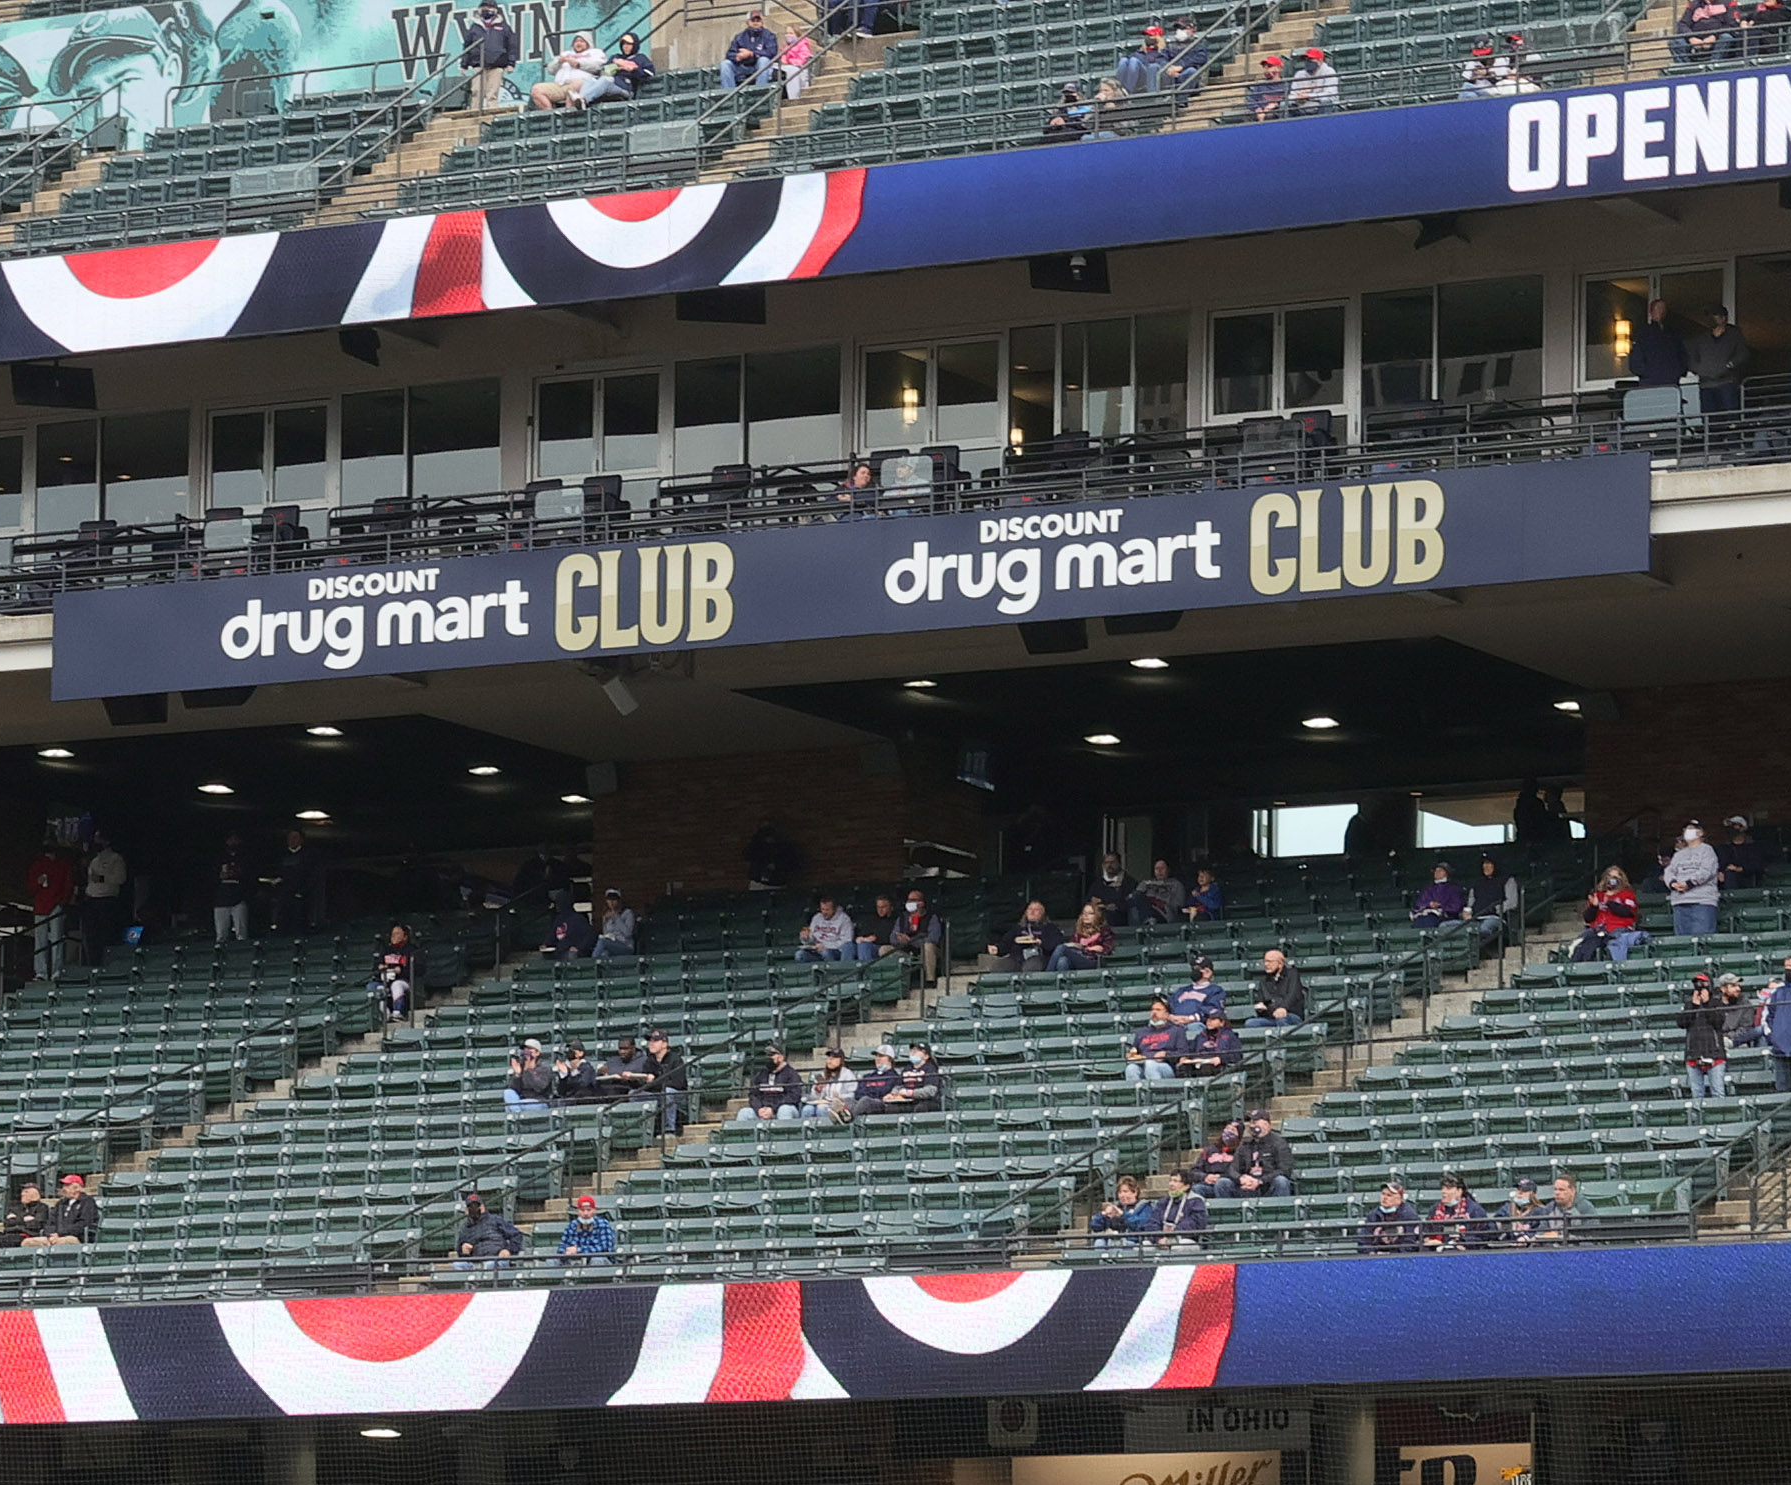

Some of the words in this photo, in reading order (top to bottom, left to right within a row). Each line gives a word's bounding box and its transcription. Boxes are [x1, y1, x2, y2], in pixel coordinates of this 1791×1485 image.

[978, 508, 1124, 544] DISCOUNT
[884, 540, 1041, 615] drug
[1055, 520, 1222, 592] mart
[1248, 479, 1446, 596] CLUB
[307, 567, 440, 602] DISCOUNT
[220, 598, 366, 670] drug
[376, 579, 529, 647] mart
[554, 540, 736, 652] CLUB
[1186, 1408, 1214, 1433] IN
[1223, 1407, 1289, 1432] OHIO
